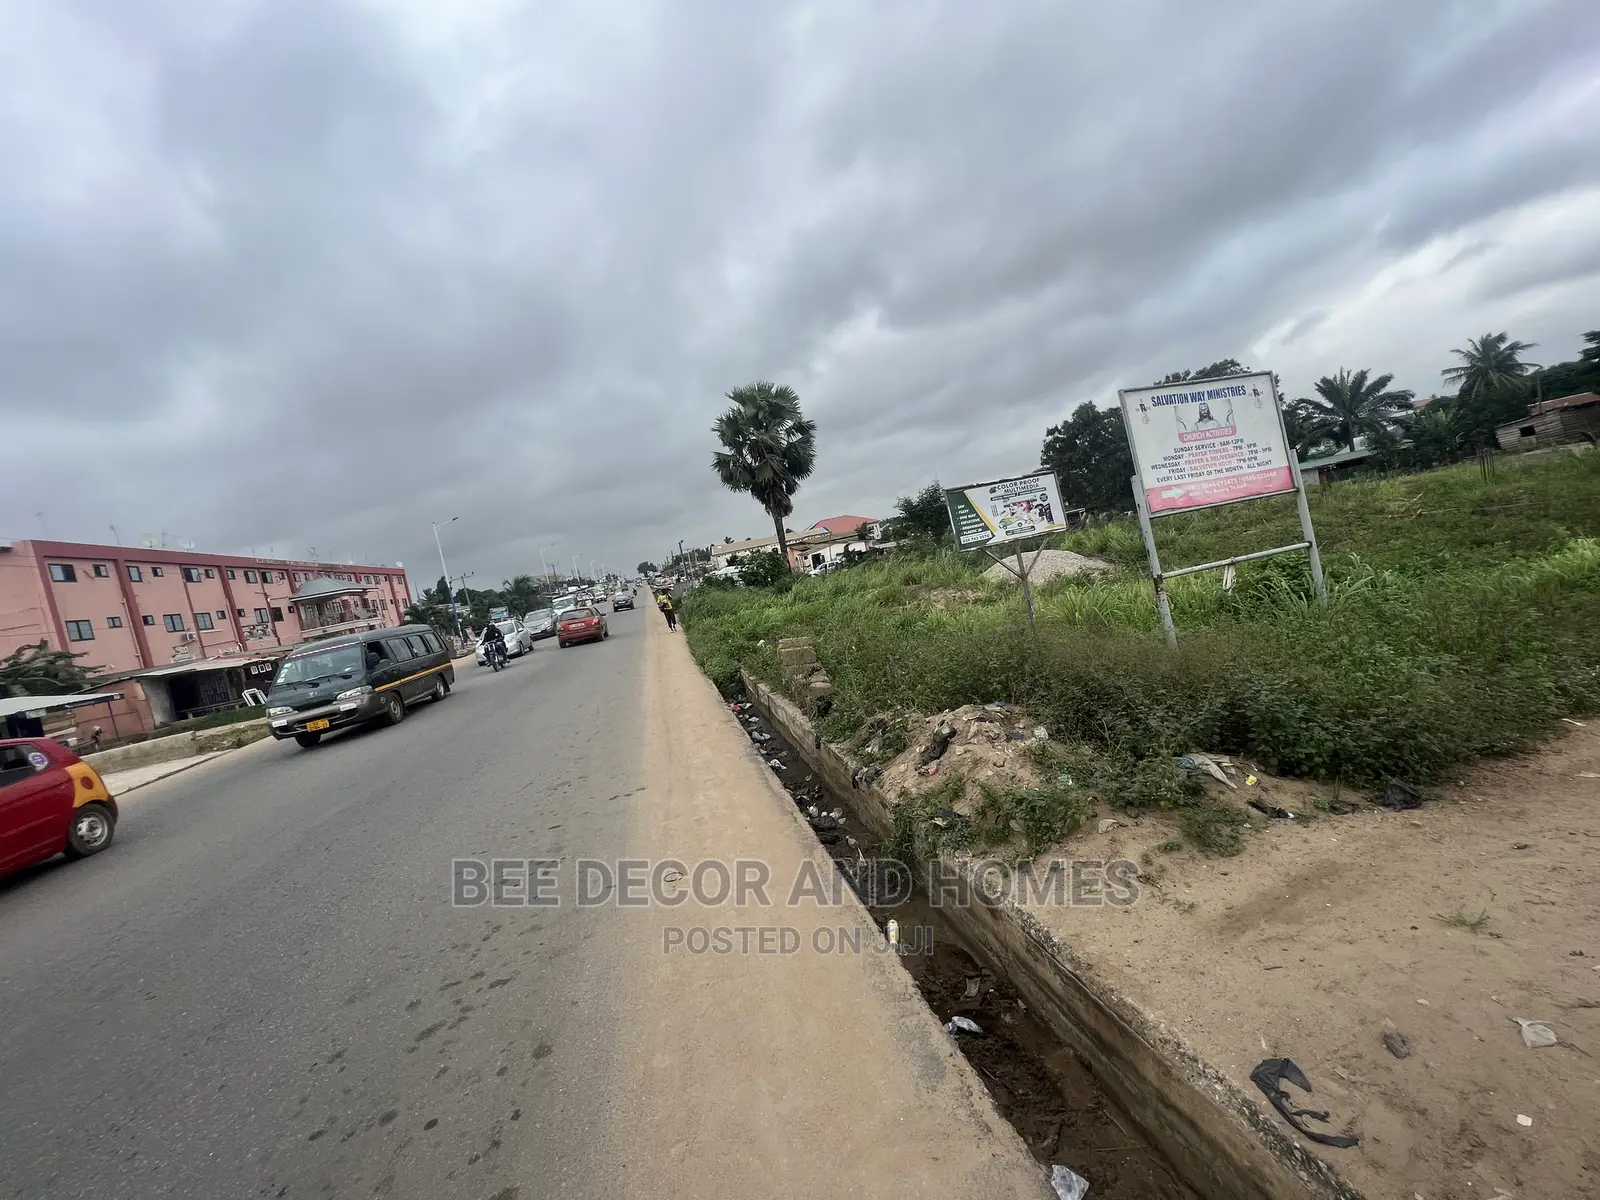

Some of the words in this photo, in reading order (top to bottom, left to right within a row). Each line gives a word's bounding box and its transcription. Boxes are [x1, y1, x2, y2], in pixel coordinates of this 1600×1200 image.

[1150, 392, 1189, 407] SALVATION
[1188, 390, 1206, 402] WAY
[1205, 384, 1247, 400] MINISTRIES
[1182, 431, 1205, 441] CHURCH
[1150, 461, 1180, 470] WEDNESDAY
[1209, 451, 1244, 461] DELIVERANCE
[1162, 453, 1184, 461] MONDAY
[1189, 462, 1217, 470] SALVATION
[996, 481, 1018, 489] COLOR
[1003, 482, 1039, 493] MULTIMEDIA
